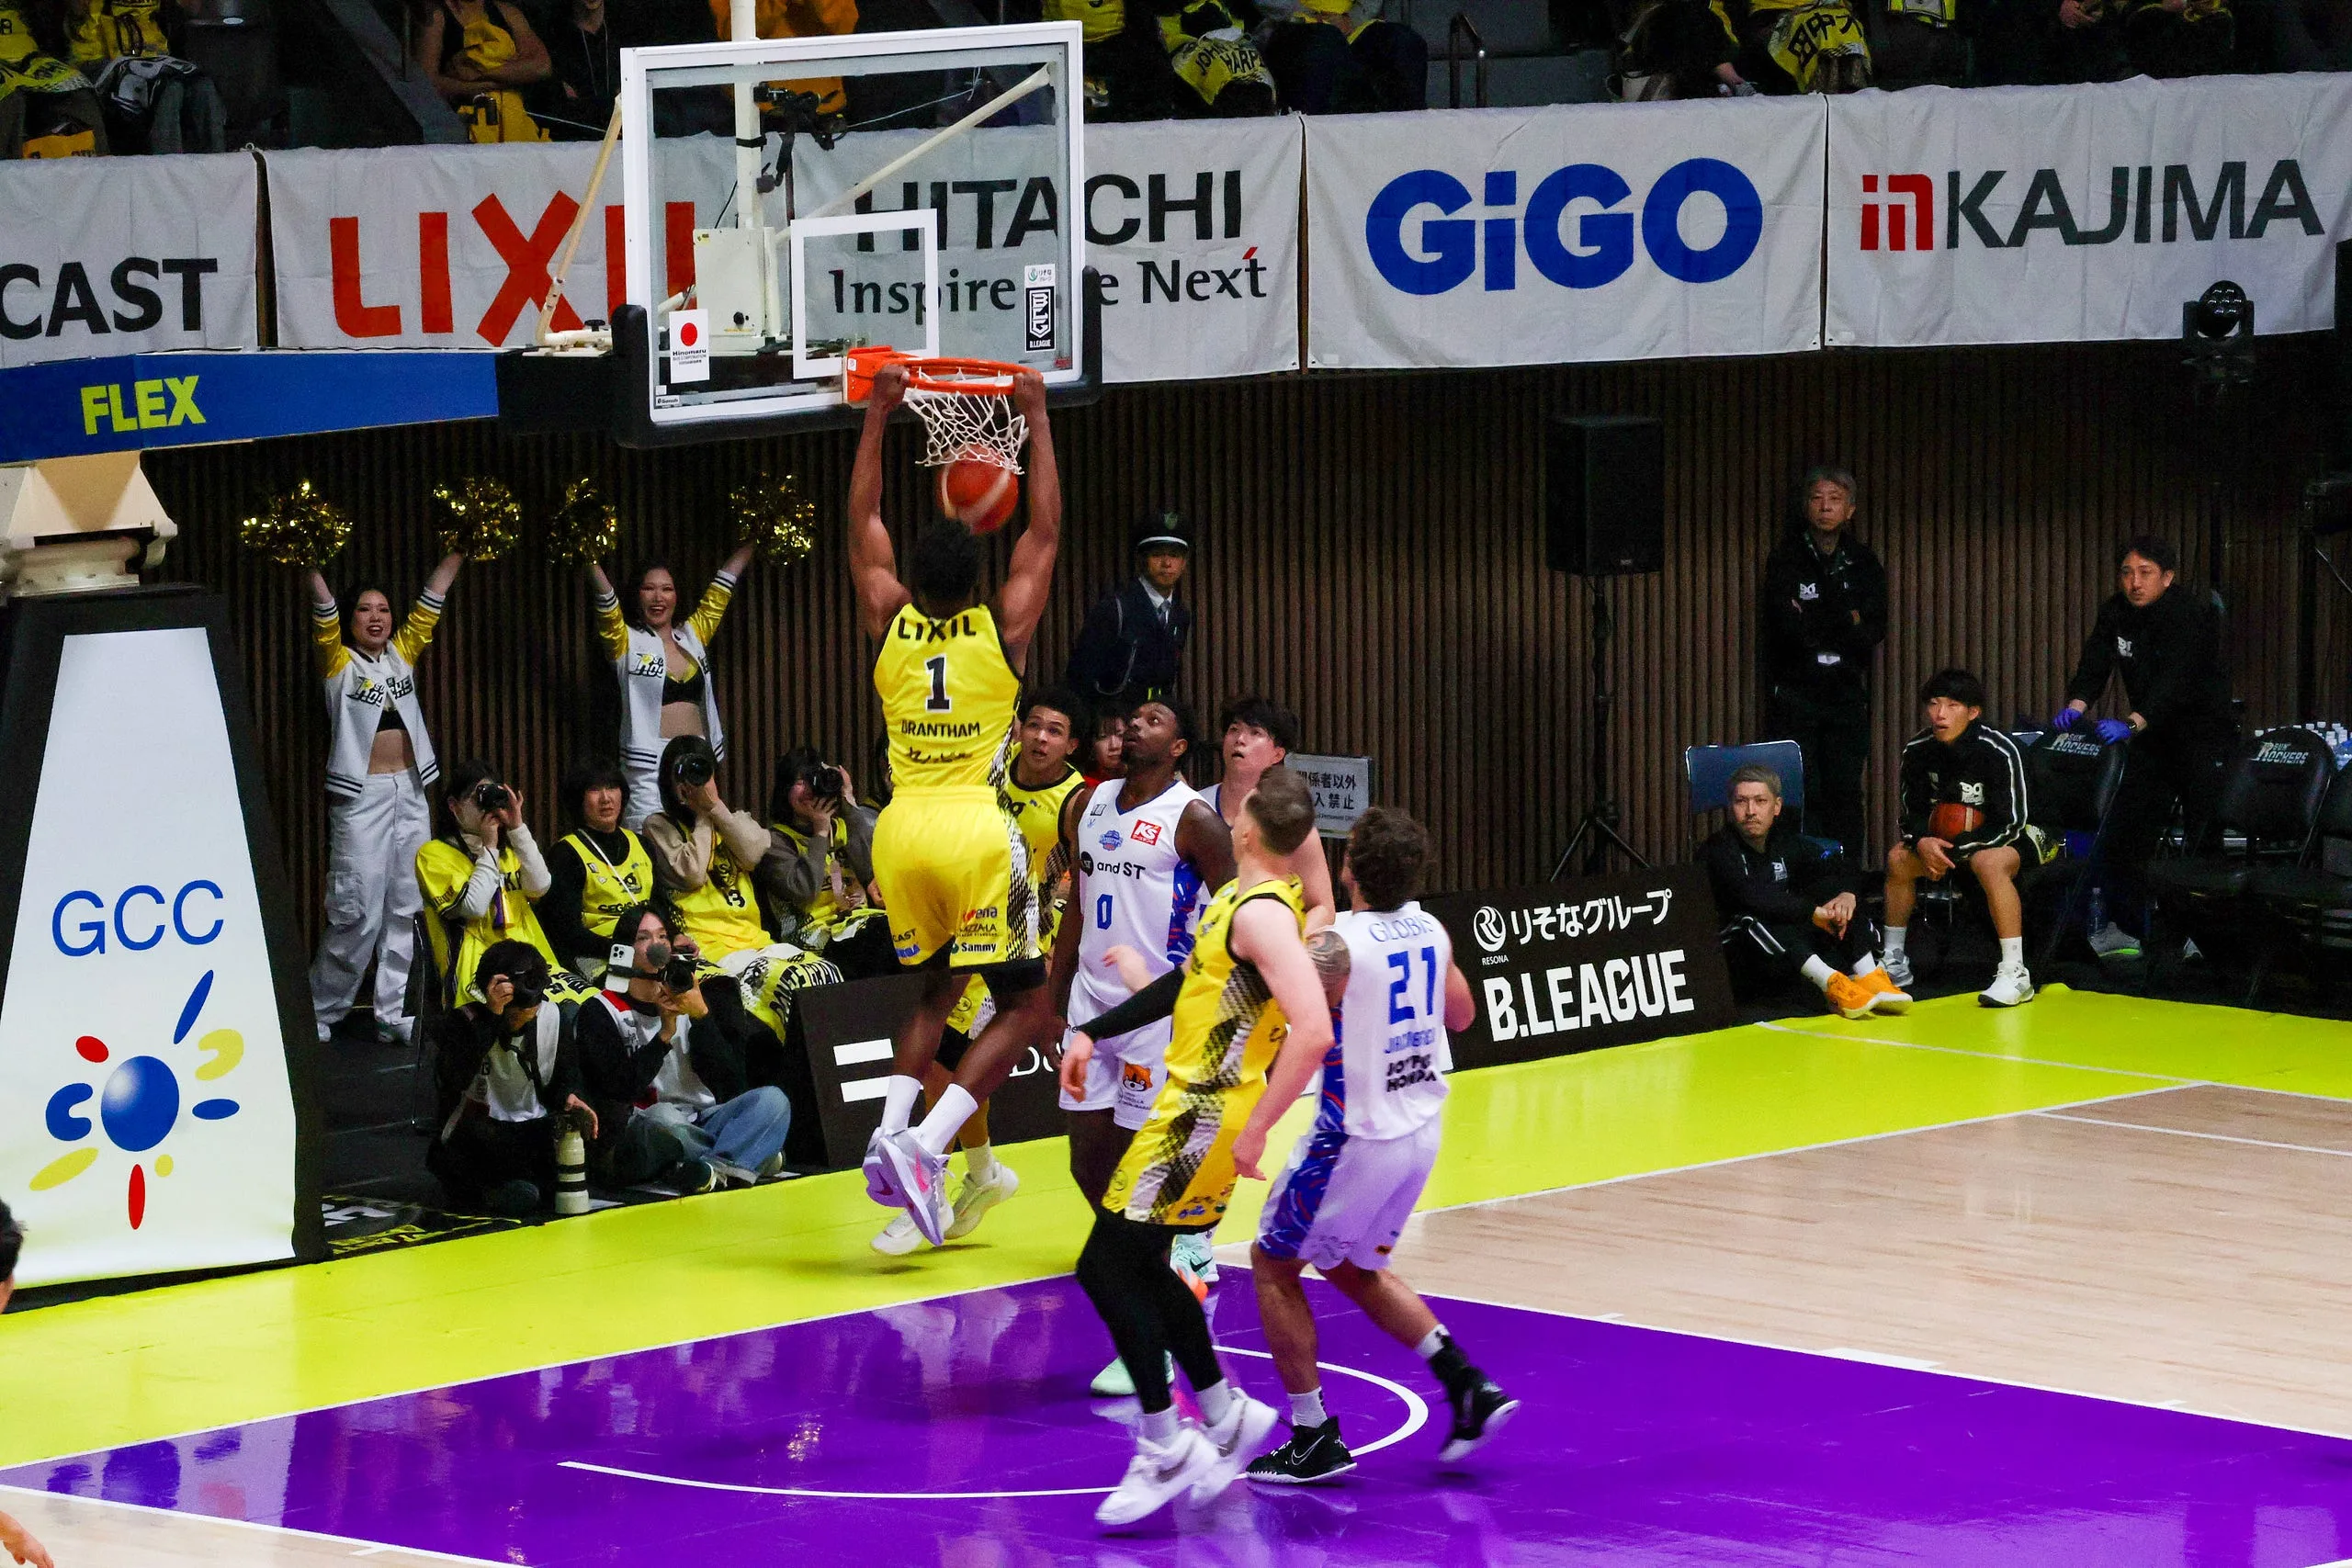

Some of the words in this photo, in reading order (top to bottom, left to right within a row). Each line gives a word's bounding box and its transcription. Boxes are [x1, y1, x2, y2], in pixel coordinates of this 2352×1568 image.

[855, 170, 1242, 252] HITACHI
[1365, 157, 1763, 296] GiGO
[1946, 159, 2325, 249] KAJIMA
[829, 268, 1016, 325] Inspire
[1142, 247, 1267, 305] Next
[81, 375, 207, 436] FLEX
[898, 615, 977, 643] LIXIL
[925, 655, 951, 711] 1
[1097, 862, 1121, 874] and
[1123, 862, 1147, 880] ST
[52, 879, 224, 957] GCC
[1096, 893, 1114, 931] 0
[1510, 887, 1673, 946] りそなグループ
[961, 942, 996, 953] Sammy
[1482, 954, 1509, 966] RESONA
[1387, 945, 1437, 1025] 21
[1483, 949, 1695, 1042] B.LEAGUE
